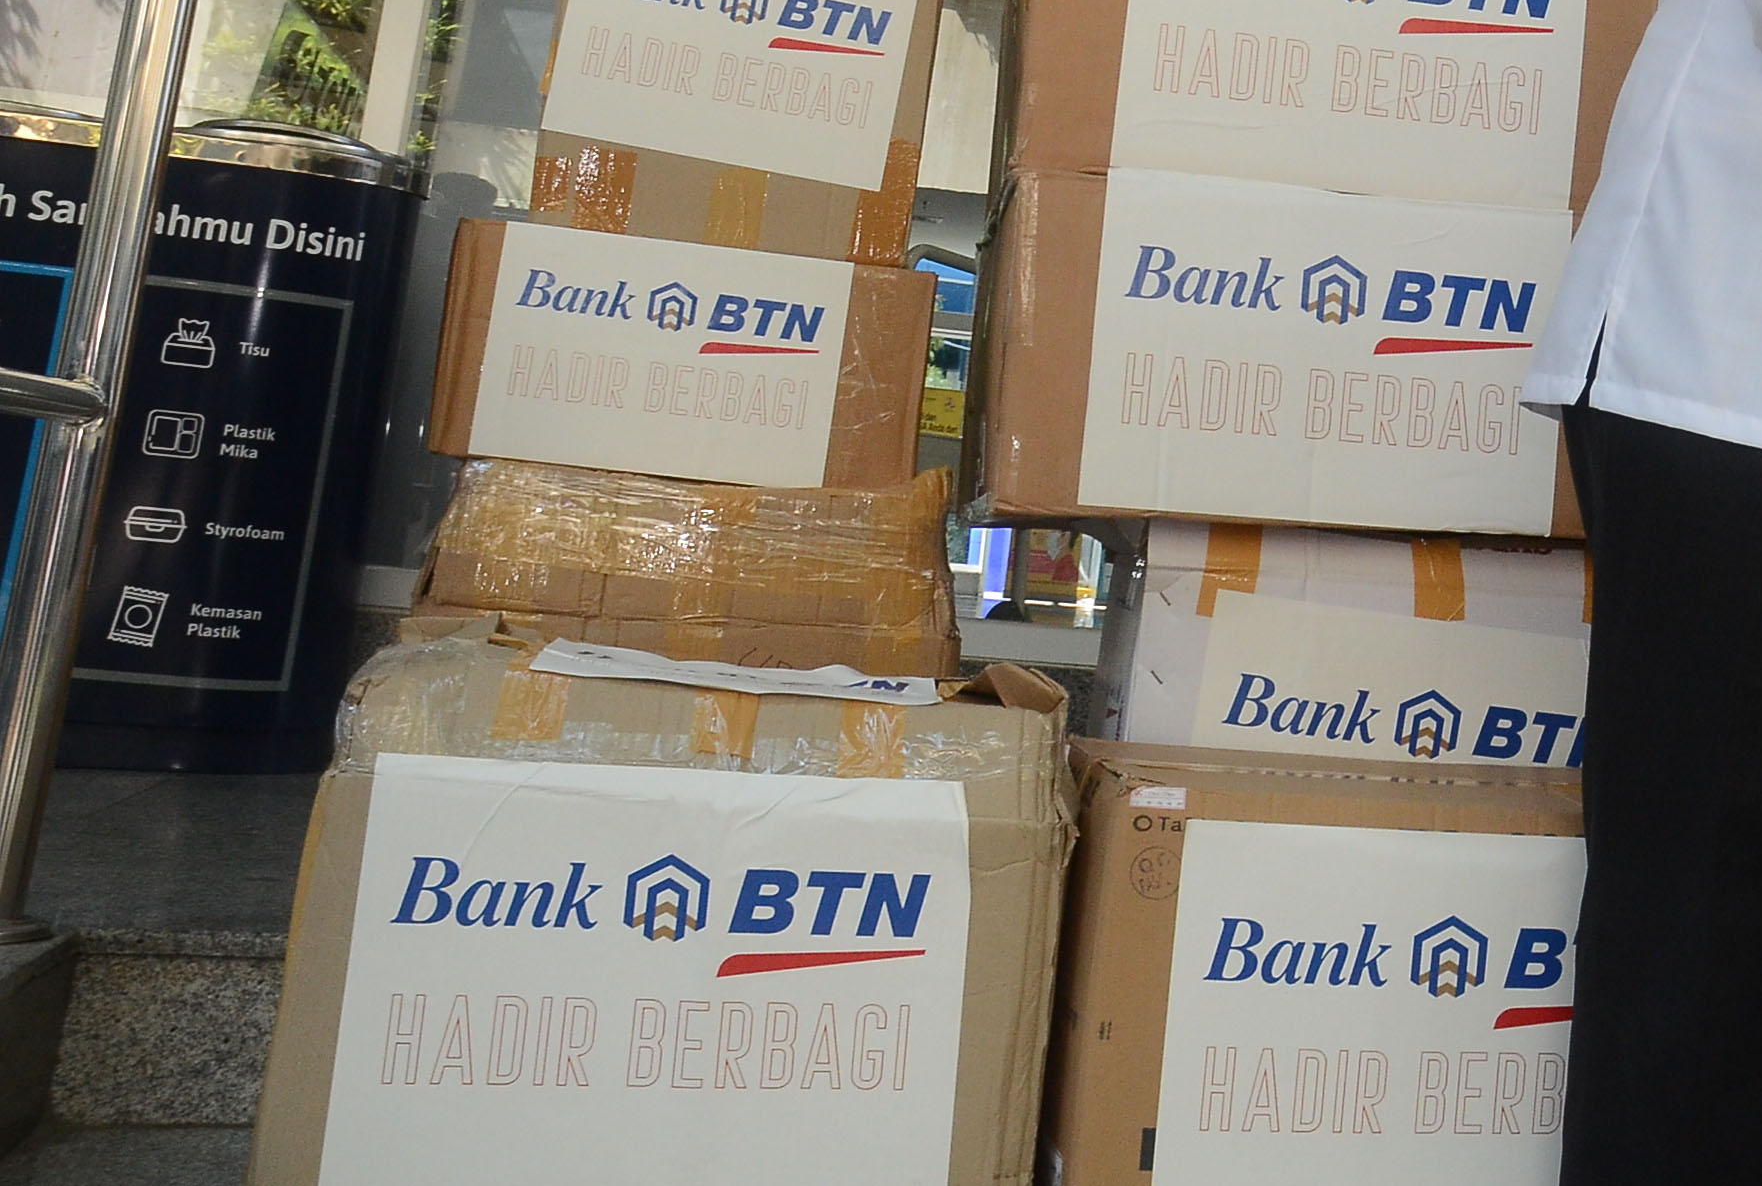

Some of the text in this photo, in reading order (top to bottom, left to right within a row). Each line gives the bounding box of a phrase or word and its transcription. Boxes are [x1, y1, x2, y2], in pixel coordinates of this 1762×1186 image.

[581, 26, 874, 129] HADIR BERBAGI
[1153, 23, 1544, 135] HADIR BERBAGI
[265, 218, 366, 261] Disini
[516, 269, 825, 343] Bank BTN
[1125, 245, 1536, 333] Bank BTN
[239, 341, 270, 357] Tisu
[507, 344, 809, 429] HADIR BERBAGI
[1120, 353, 1522, 456] HADIR BERBAGI
[219, 443, 259, 459] Mika
[223, 424, 276, 441] Plastik
[205, 522, 285, 541] Styrofoam
[187, 623, 241, 639] Plastik
[190, 603, 262, 621] Kemasan
[1222, 673, 1380, 744] Bank
[391, 856, 931, 938] Bank BTN
[1203, 917, 1392, 987] Bank
[381, 994, 910, 1091] HADIR BERBAGI
[1200, 1046, 1566, 1135] HADIR BERB
